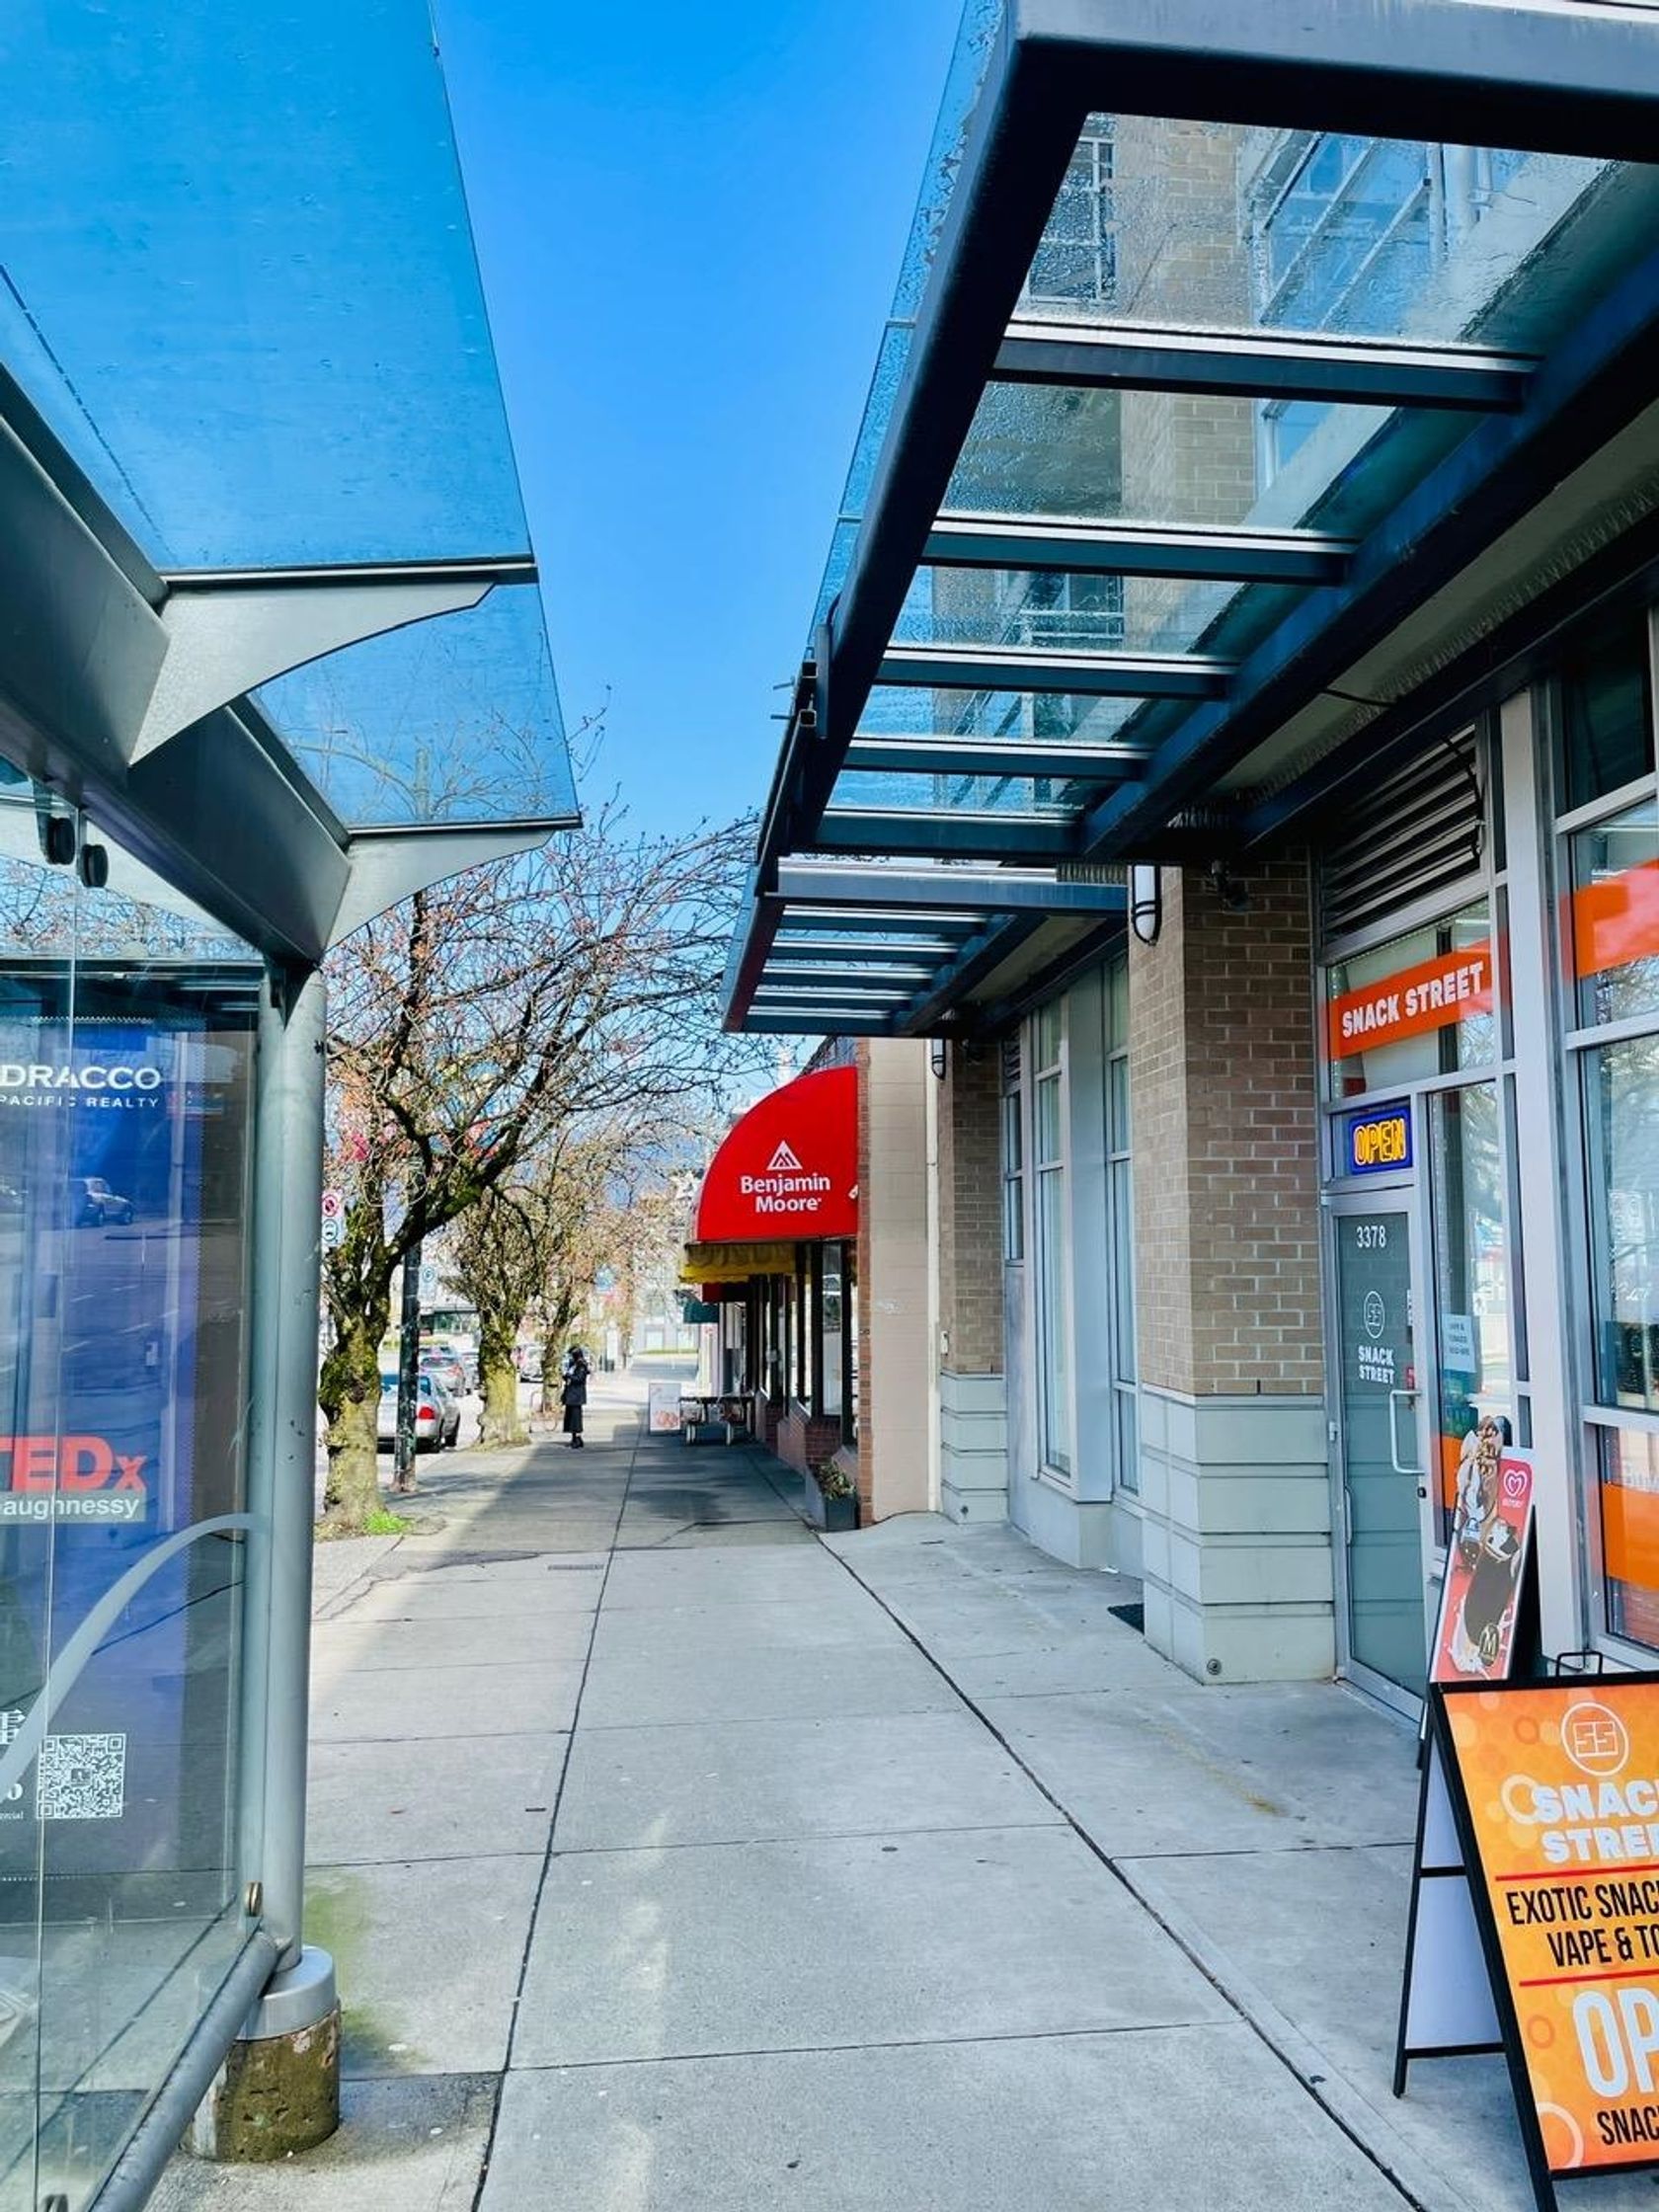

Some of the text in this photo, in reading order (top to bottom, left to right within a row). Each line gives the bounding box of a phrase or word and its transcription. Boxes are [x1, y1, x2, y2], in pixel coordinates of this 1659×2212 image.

[1342, 961, 1484, 1039] SNACK STREET
[0, 1065, 161, 1090] DRACCO
[86, 1097, 159, 1108] REALTY
[1354, 1118, 1406, 1166] OPEN
[741, 1172, 830, 1197] Benjamin
[755, 1196, 819, 1213] Moore
[1356, 1224, 1386, 1248] 3378
[1358, 1345, 1394, 1366] SNACK
[1359, 1365, 1394, 1384] STREET
[0, 1498, 139, 1520] aughnessy
[1532, 1779, 1659, 1824] SNAC
[1506, 1880, 1659, 1925] EXOTIC SNAC
[1547, 1929, 1612, 1967] VAPE
[1615, 1927, 1634, 1961] &
[1597, 2104, 1659, 2145] SNAC
